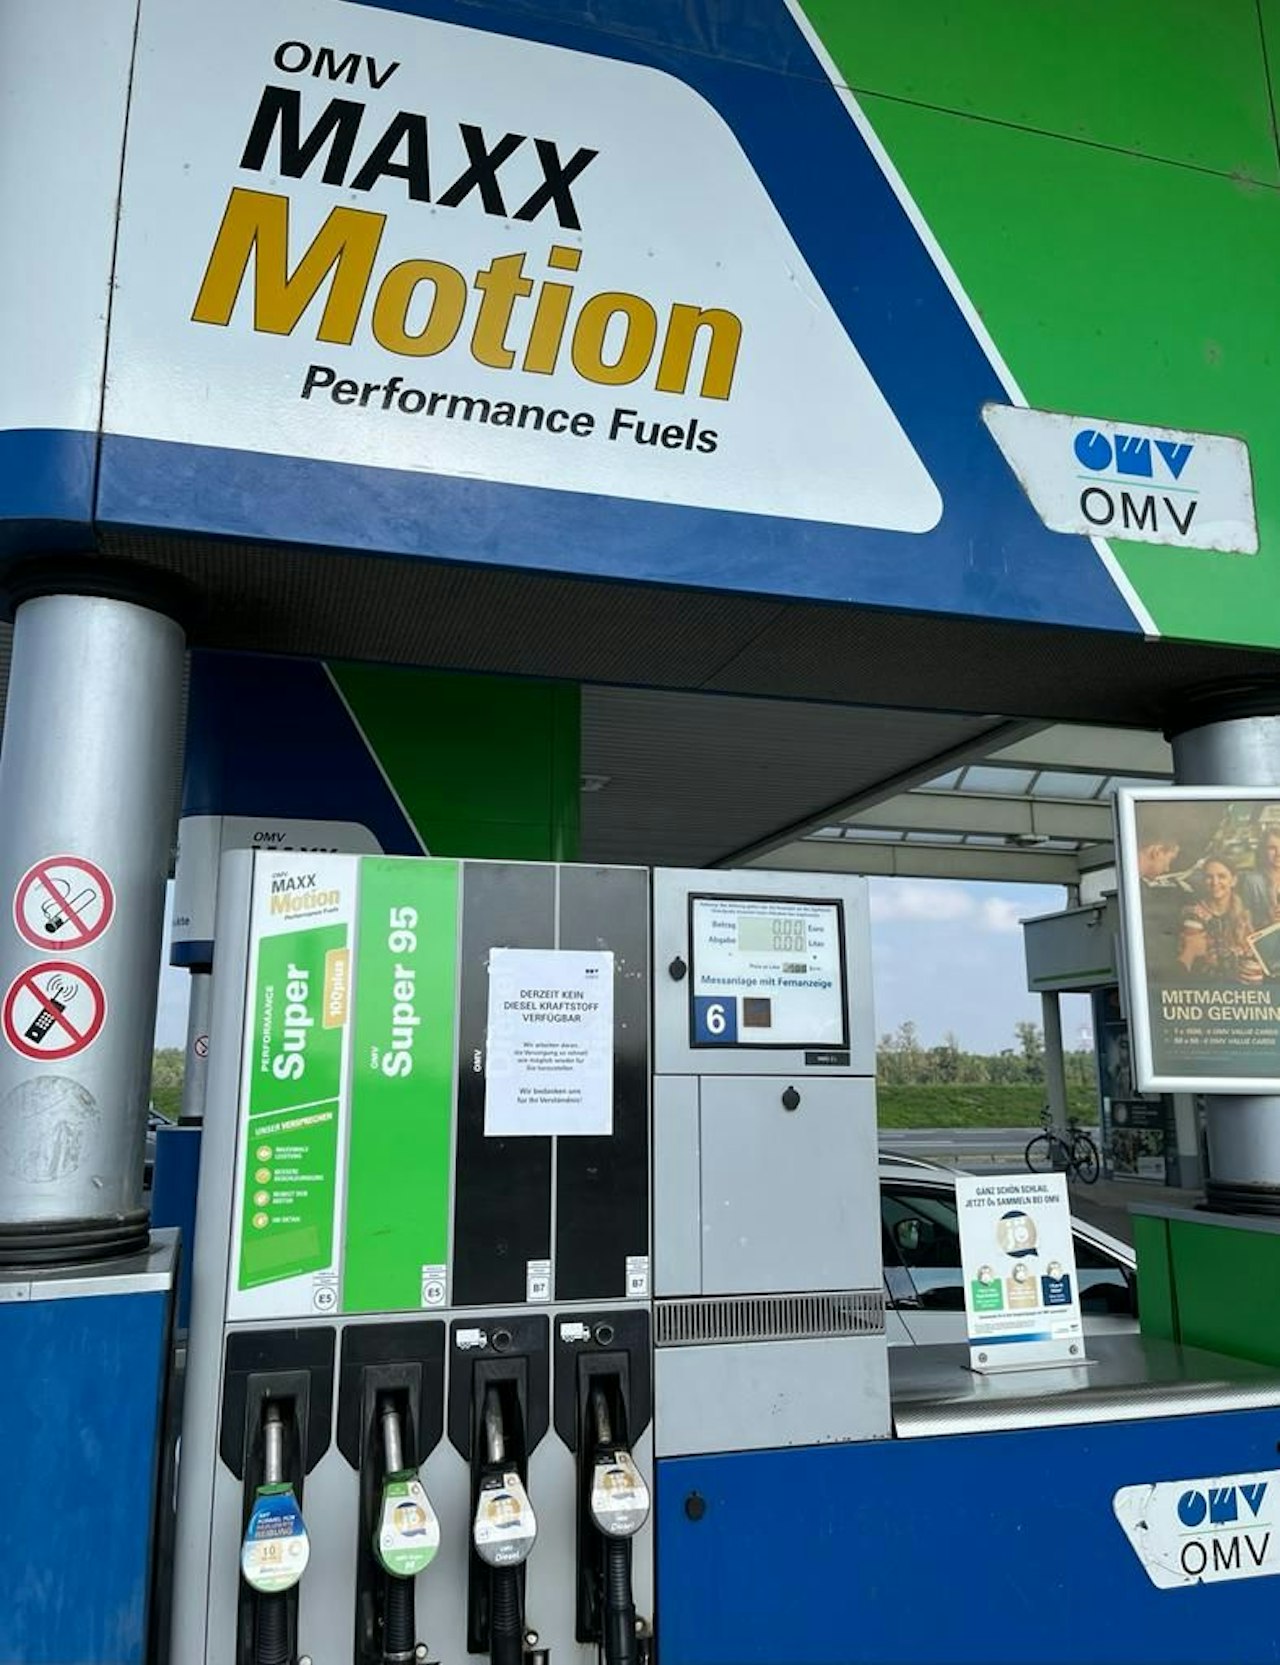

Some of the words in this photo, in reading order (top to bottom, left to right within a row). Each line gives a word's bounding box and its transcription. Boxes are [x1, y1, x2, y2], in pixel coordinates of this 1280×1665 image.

[273, 41, 400, 89] OMV
[239, 85, 599, 230] MAXX
[190, 186, 742, 400] Motion
[301, 365, 596, 438] Performance
[609, 408, 718, 454] Fuels
[1080, 487, 1197, 535] OMV
[253, 831, 287, 843] OMV
[271, 873, 316, 893] MAXX
[270, 889, 340, 916] Motion
[388, 906, 418, 953] 95
[712, 920, 736, 931] Betrag
[808, 924, 824, 932] Euro
[709, 936, 736, 946] Abgabe
[329, 959, 345, 1018] 100plus
[701, 975, 757, 988] Messanlage
[759, 975, 775, 986] mit
[520, 989, 560, 999] DERZEIT
[562, 990, 584, 1000] KEIN
[1161, 989, 1272, 1005] MITMACHEN
[504, 1001, 537, 1010] DIESEL
[539, 1002, 599, 1012] KRAFTSTOFF
[1163, 1005, 1203, 1021] UND
[273, 963, 315, 1081] Super
[382, 963, 421, 1077] Super
[522, 1011, 582, 1022] VERFÜGBAR
[706, 1003, 726, 1034] 6
[261, 985, 274, 1073] PERFORMANCE
[370, 1046, 379, 1070] OMV
[975, 1186, 995, 1196] GANZ
[996, 1184, 1020, 1195] SCHÖN
[965, 1198, 985, 1208] JETZT
[996, 1196, 1031, 1206] SAMMELN
[1032, 1195, 1043, 1204] BEI
[1044, 1195, 1060, 1204] OMV
[533, 1283, 545, 1293] B7
[632, 1278, 644, 1288] B7
[318, 1294, 332, 1303] E5
[427, 1287, 441, 1298] E5
[495, 1550, 520, 1562] Diesel
[1181, 1532, 1271, 1576] OMV
